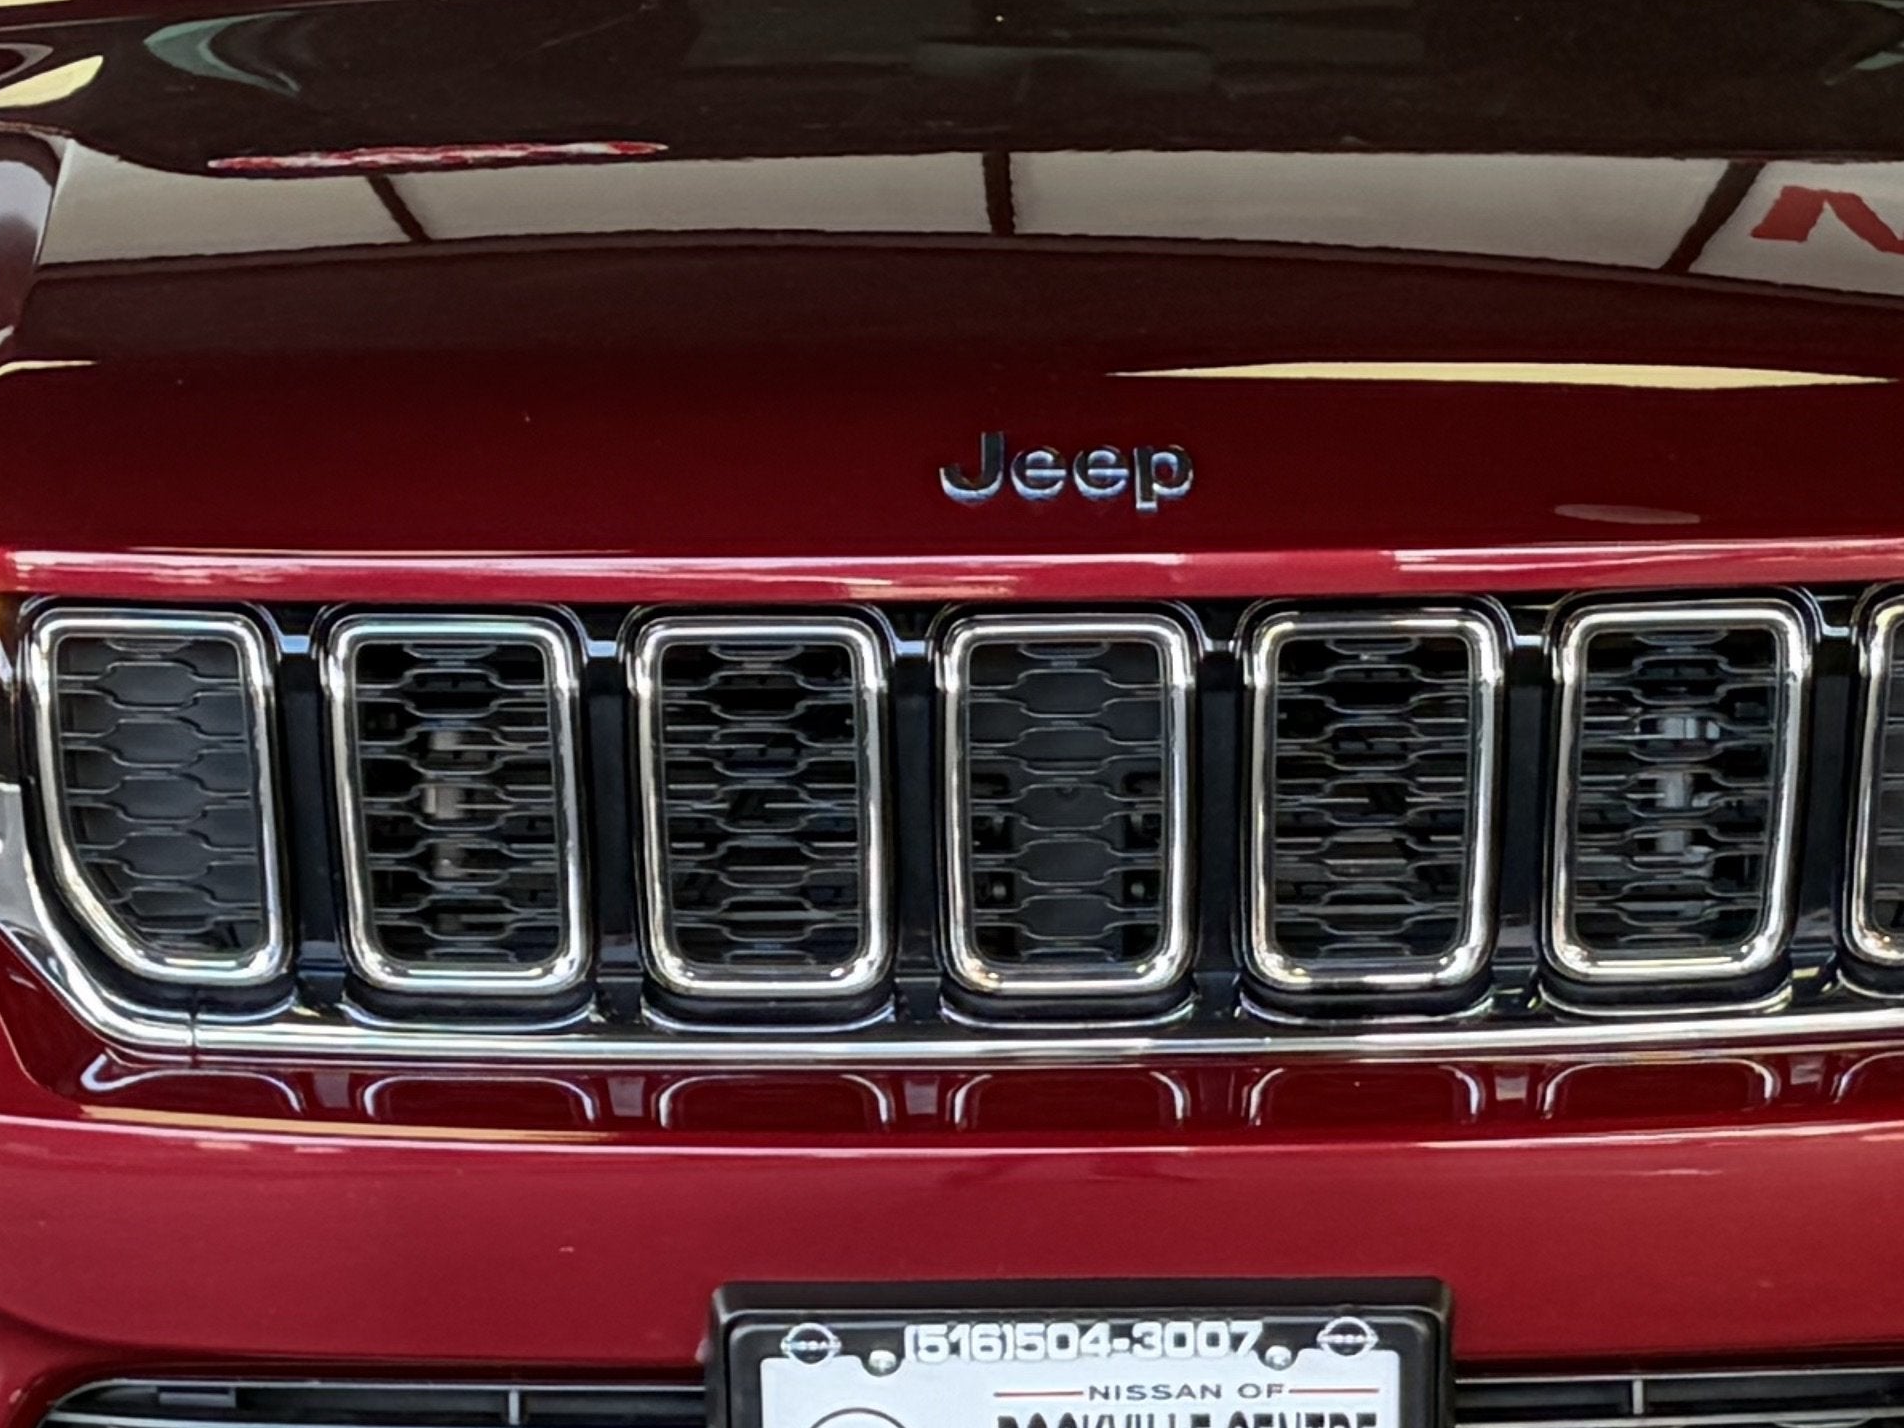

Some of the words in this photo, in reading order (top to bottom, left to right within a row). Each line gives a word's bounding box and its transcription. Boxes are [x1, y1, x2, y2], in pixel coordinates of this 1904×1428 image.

[938, 430, 1194, 513] Jeep
[1089, 1383, 1222, 1402] NISSAN
[1237, 1383, 1285, 1400] OF
